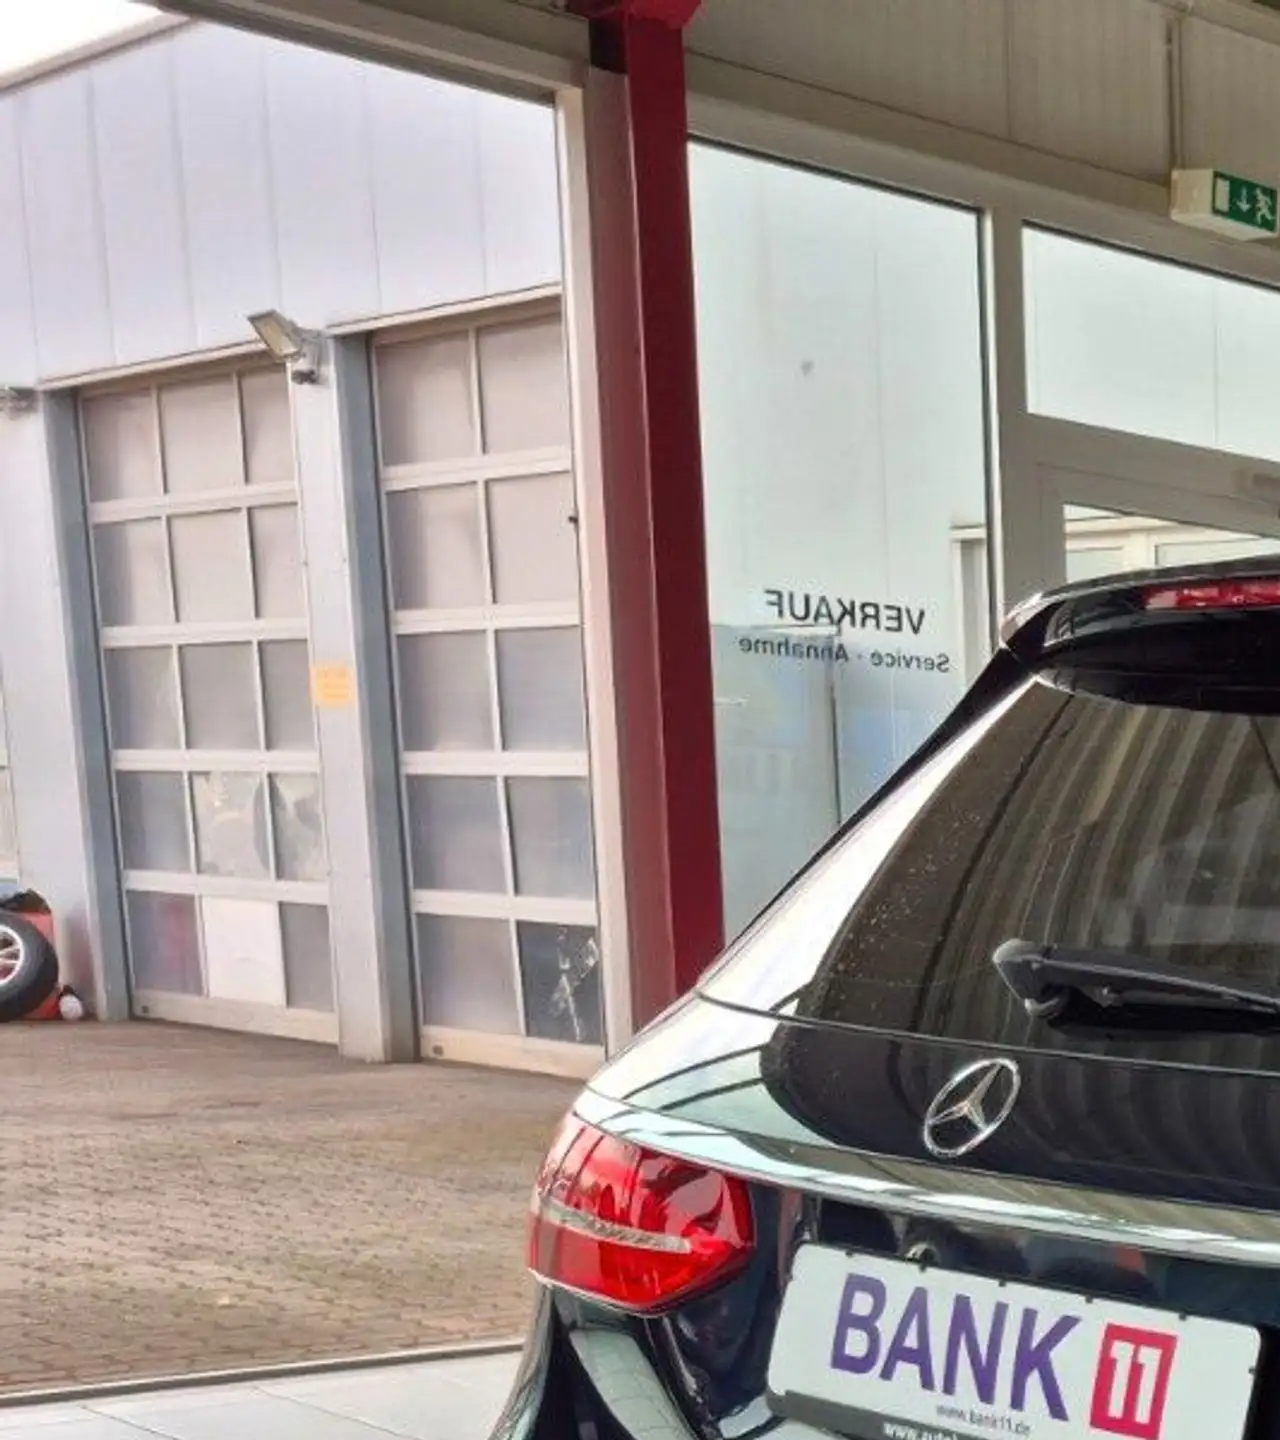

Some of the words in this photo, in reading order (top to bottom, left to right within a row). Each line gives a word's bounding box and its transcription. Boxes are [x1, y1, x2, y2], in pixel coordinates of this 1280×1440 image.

[831, 1272, 1081, 1421] BANK
[1109, 1340, 1160, 1425] 11
[937, 1405, 1031, 1435] www.bank11.de
